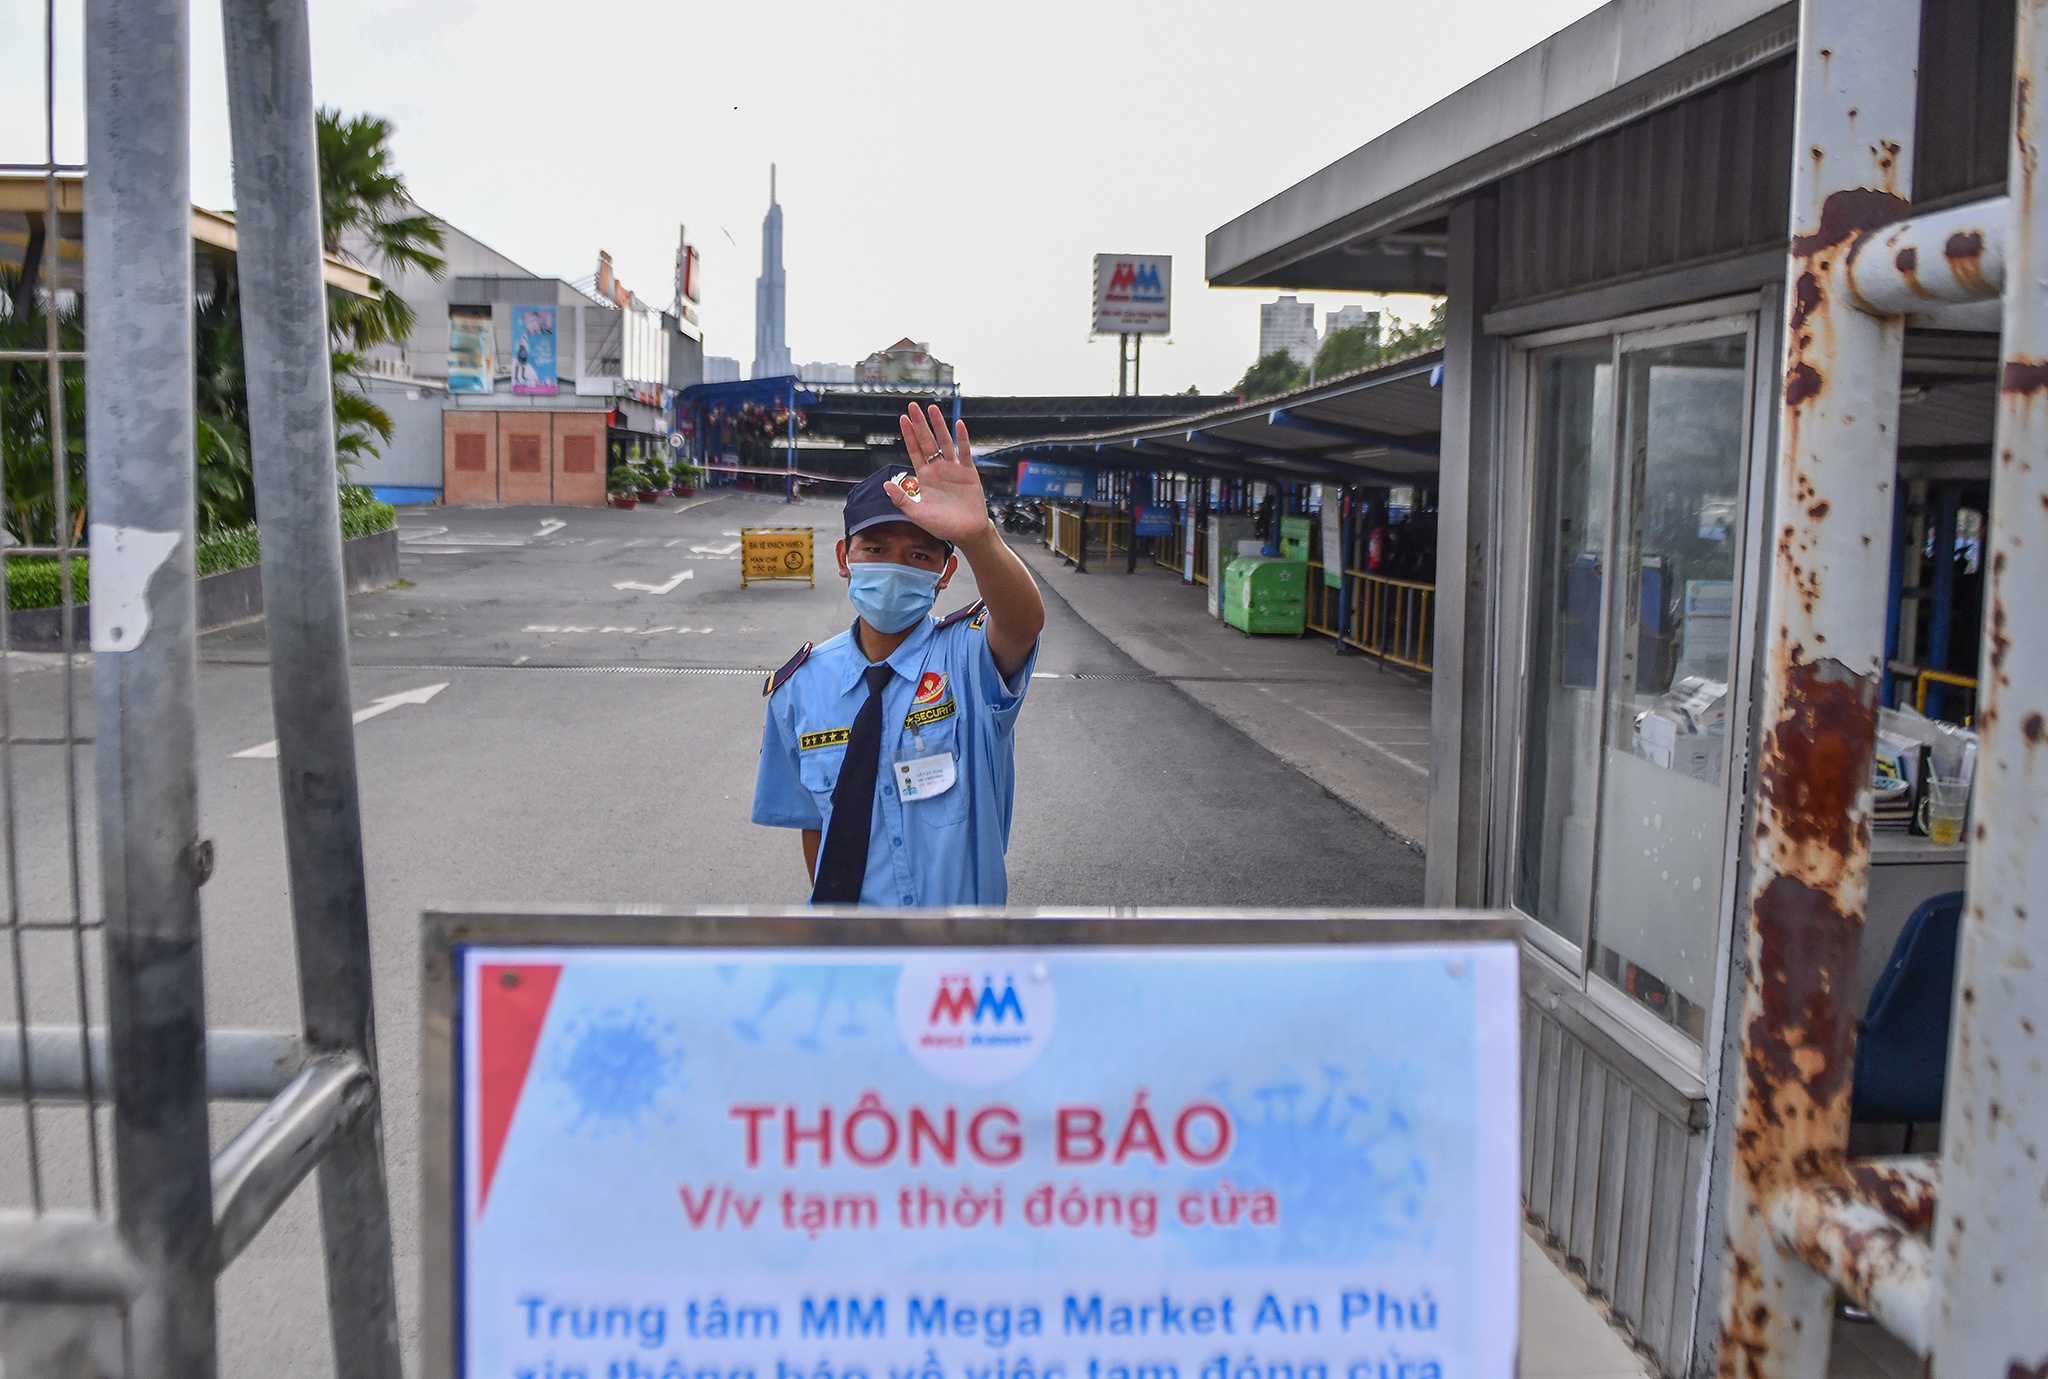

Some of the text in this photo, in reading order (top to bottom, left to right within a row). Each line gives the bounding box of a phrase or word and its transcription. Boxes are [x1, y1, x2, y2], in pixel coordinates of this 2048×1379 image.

[790, 553, 797, 561] 5
[914, 703, 956, 722] SECURIT
[729, 1088, 1234, 1168] THÔNG BÁO
[679, 1179, 1278, 1239] V/v tạm thời đóng cửa
[518, 1295, 667, 1348] Trung
[685, 1296, 781, 1340] tâm
[800, 1296, 887, 1339] MM
[906, 1295, 1043, 1346] Mega
[1062, 1293, 1235, 1335] Market
[1252, 1292, 1321, 1334] An
